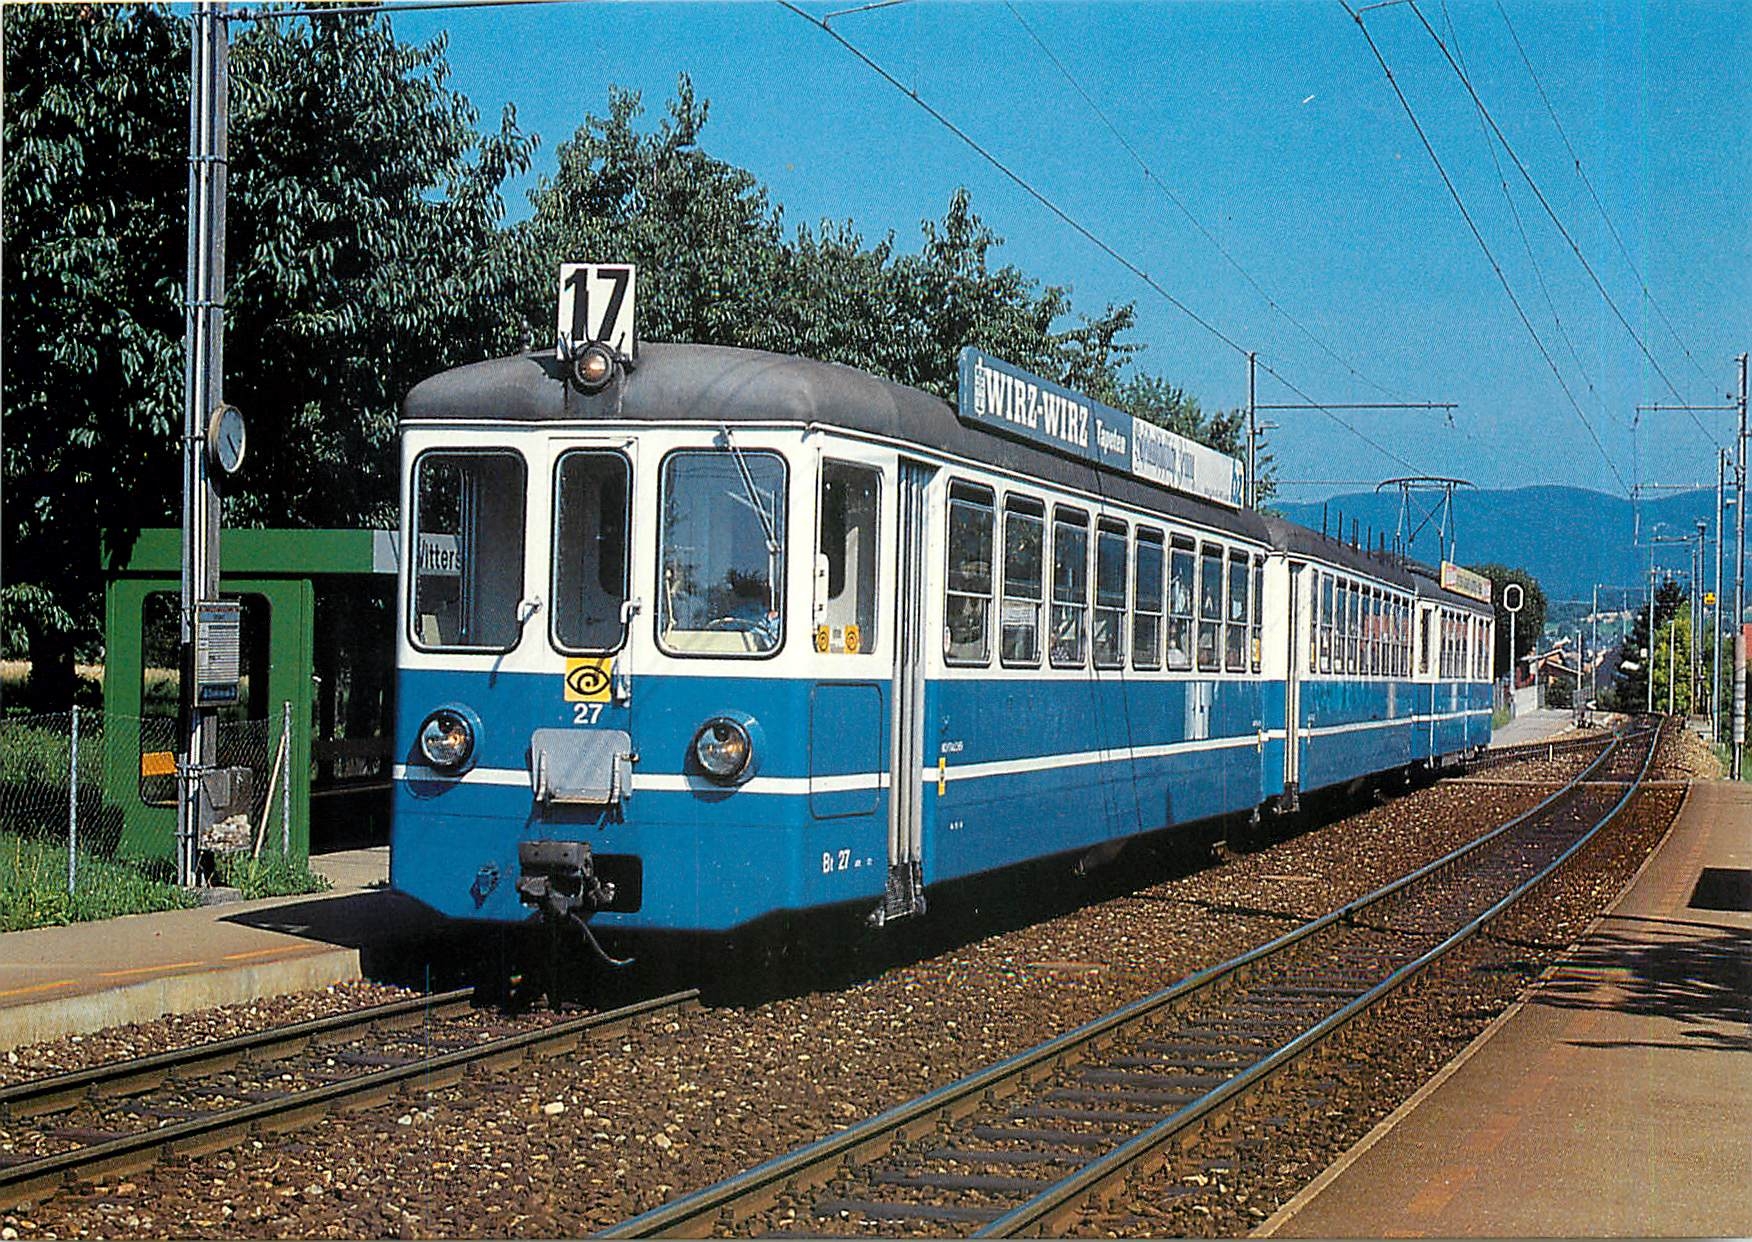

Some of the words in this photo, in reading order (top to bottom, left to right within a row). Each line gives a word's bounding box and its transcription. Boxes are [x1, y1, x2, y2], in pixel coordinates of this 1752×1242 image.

[564, 268, 630, 341] 17
[984, 366, 1089, 448] WIRZ-WIRZ
[573, 703, 604, 725] 27
[838, 848, 851, 870] 27
